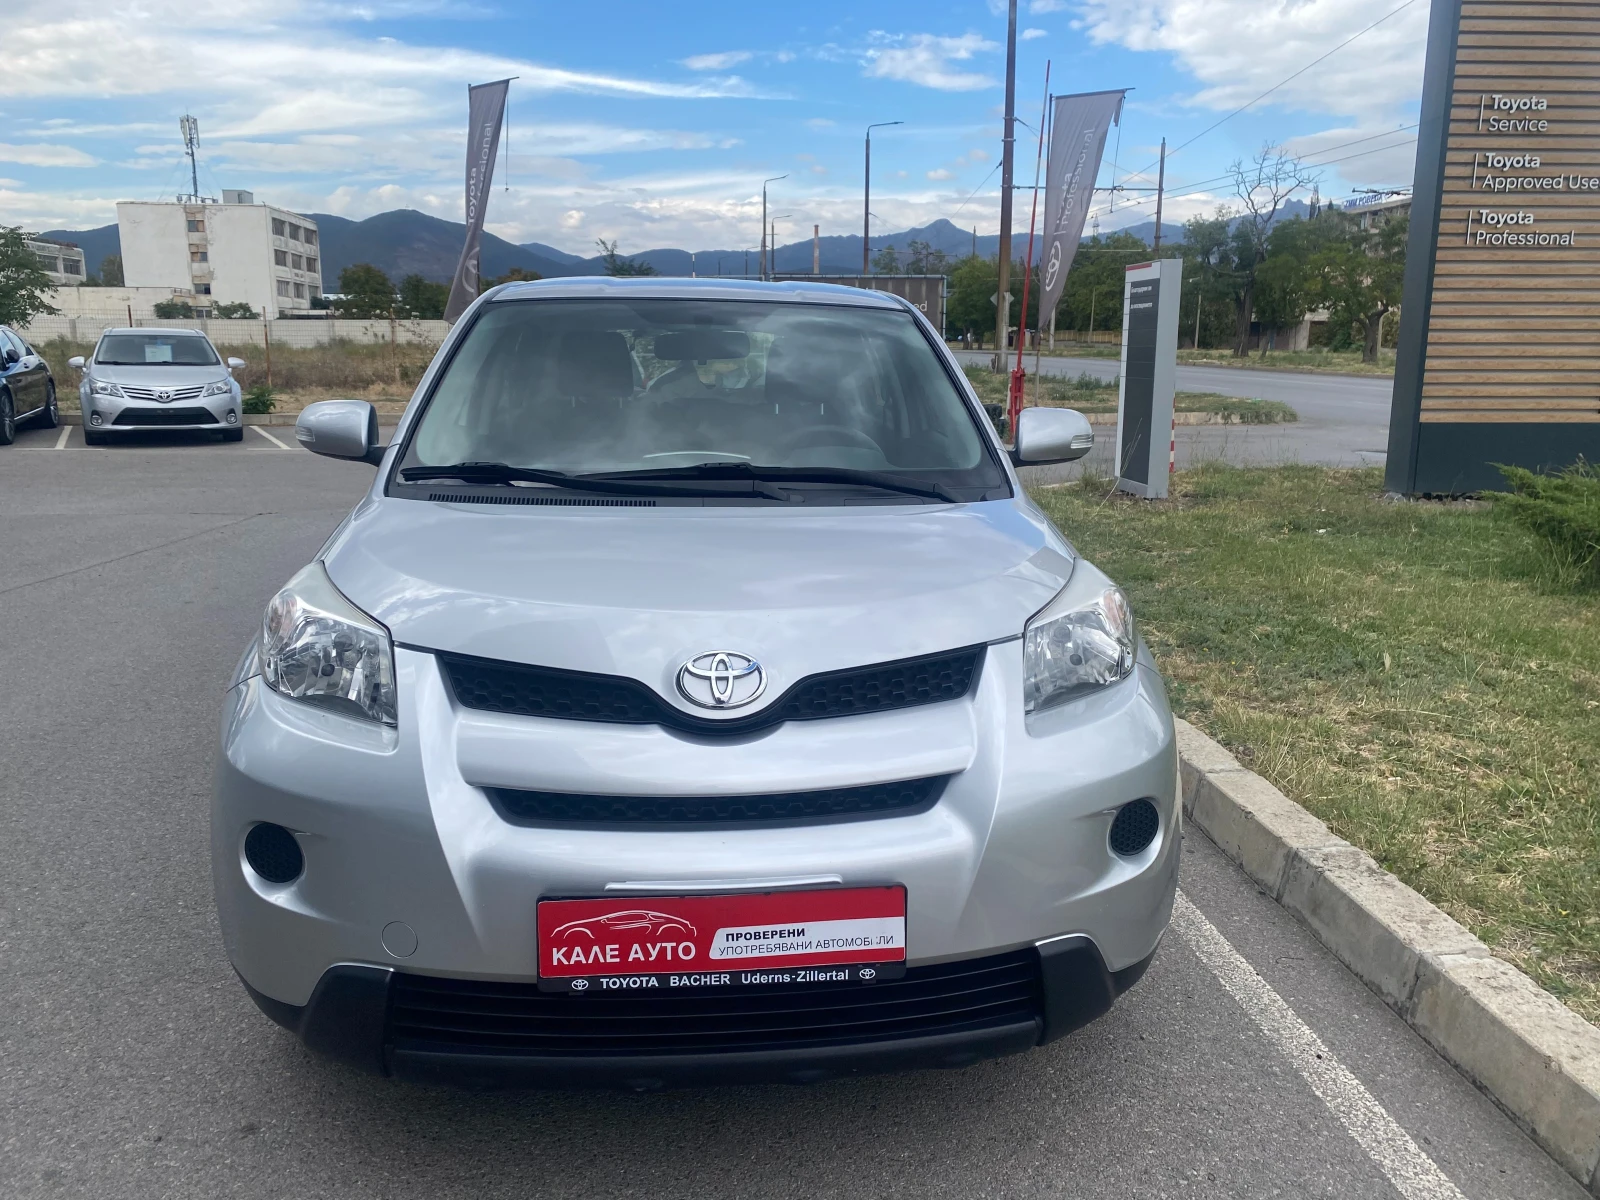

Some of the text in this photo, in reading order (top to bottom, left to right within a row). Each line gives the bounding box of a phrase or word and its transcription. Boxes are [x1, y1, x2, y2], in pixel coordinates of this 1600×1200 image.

[1491, 94, 1548, 114] Toyota
[1488, 116, 1548, 132] Service
[1485, 152, 1541, 172] Toyota
[1482, 174, 1600, 192] Approved Use
[468, 167, 477, 226] Toyota
[1479, 210, 1534, 228] Toyota
[1476, 231, 1575, 246] Professional
[725, 928, 806, 943] ПРОВЕРЕНИ
[628, 941, 696, 962] АУТО
[718, 941, 813, 957] УПОТРЕБЯВАНИ
[600, 969, 849, 989] TOYOTA BACHER Uderns-Zillertal
